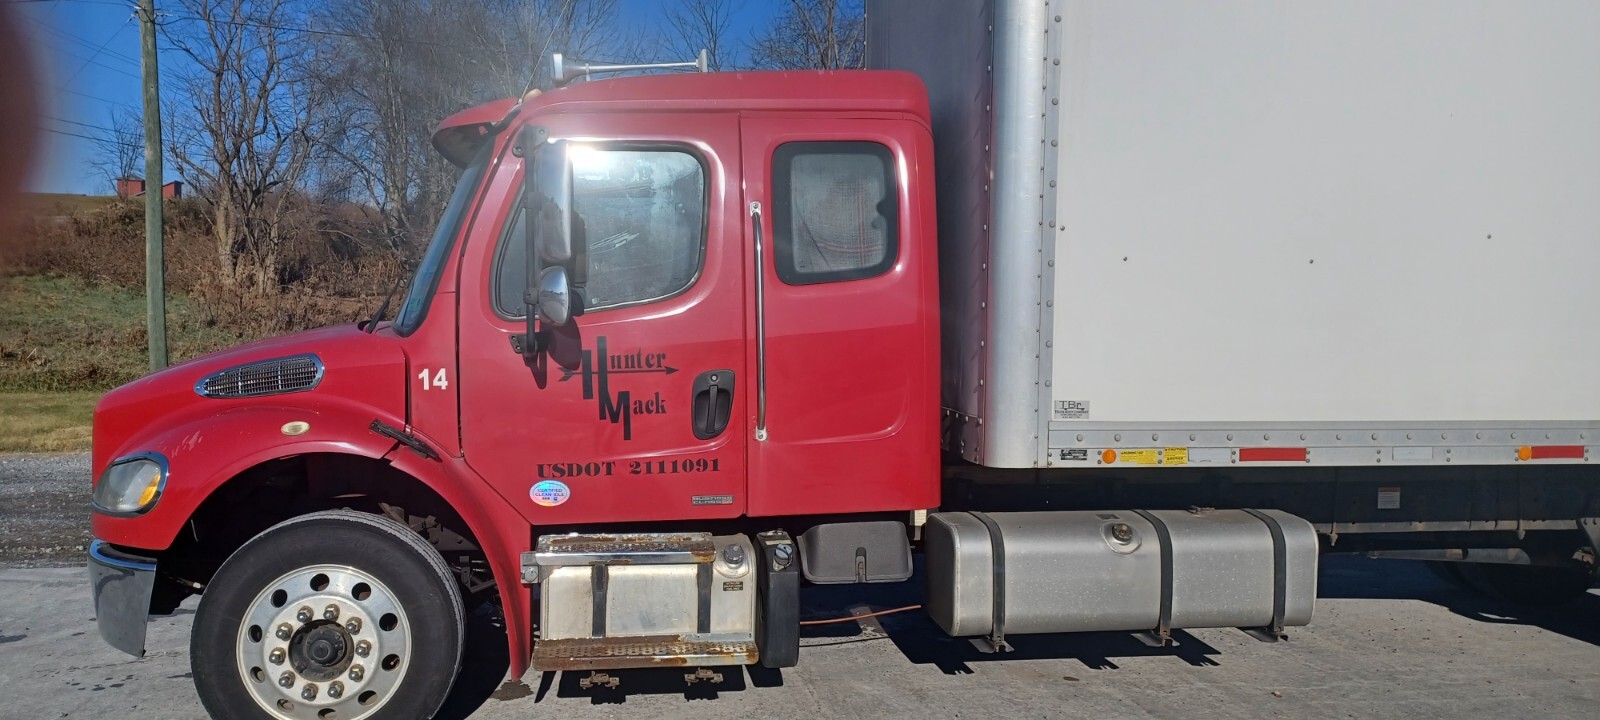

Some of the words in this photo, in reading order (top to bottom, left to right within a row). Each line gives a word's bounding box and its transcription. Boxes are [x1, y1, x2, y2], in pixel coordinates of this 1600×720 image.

[418, 368, 448, 390] 14
[582, 336, 667, 400] Hunter
[598, 390, 667, 440] Mack
[537, 461, 616, 478] USDOT
[629, 458, 720, 475] 2111091
